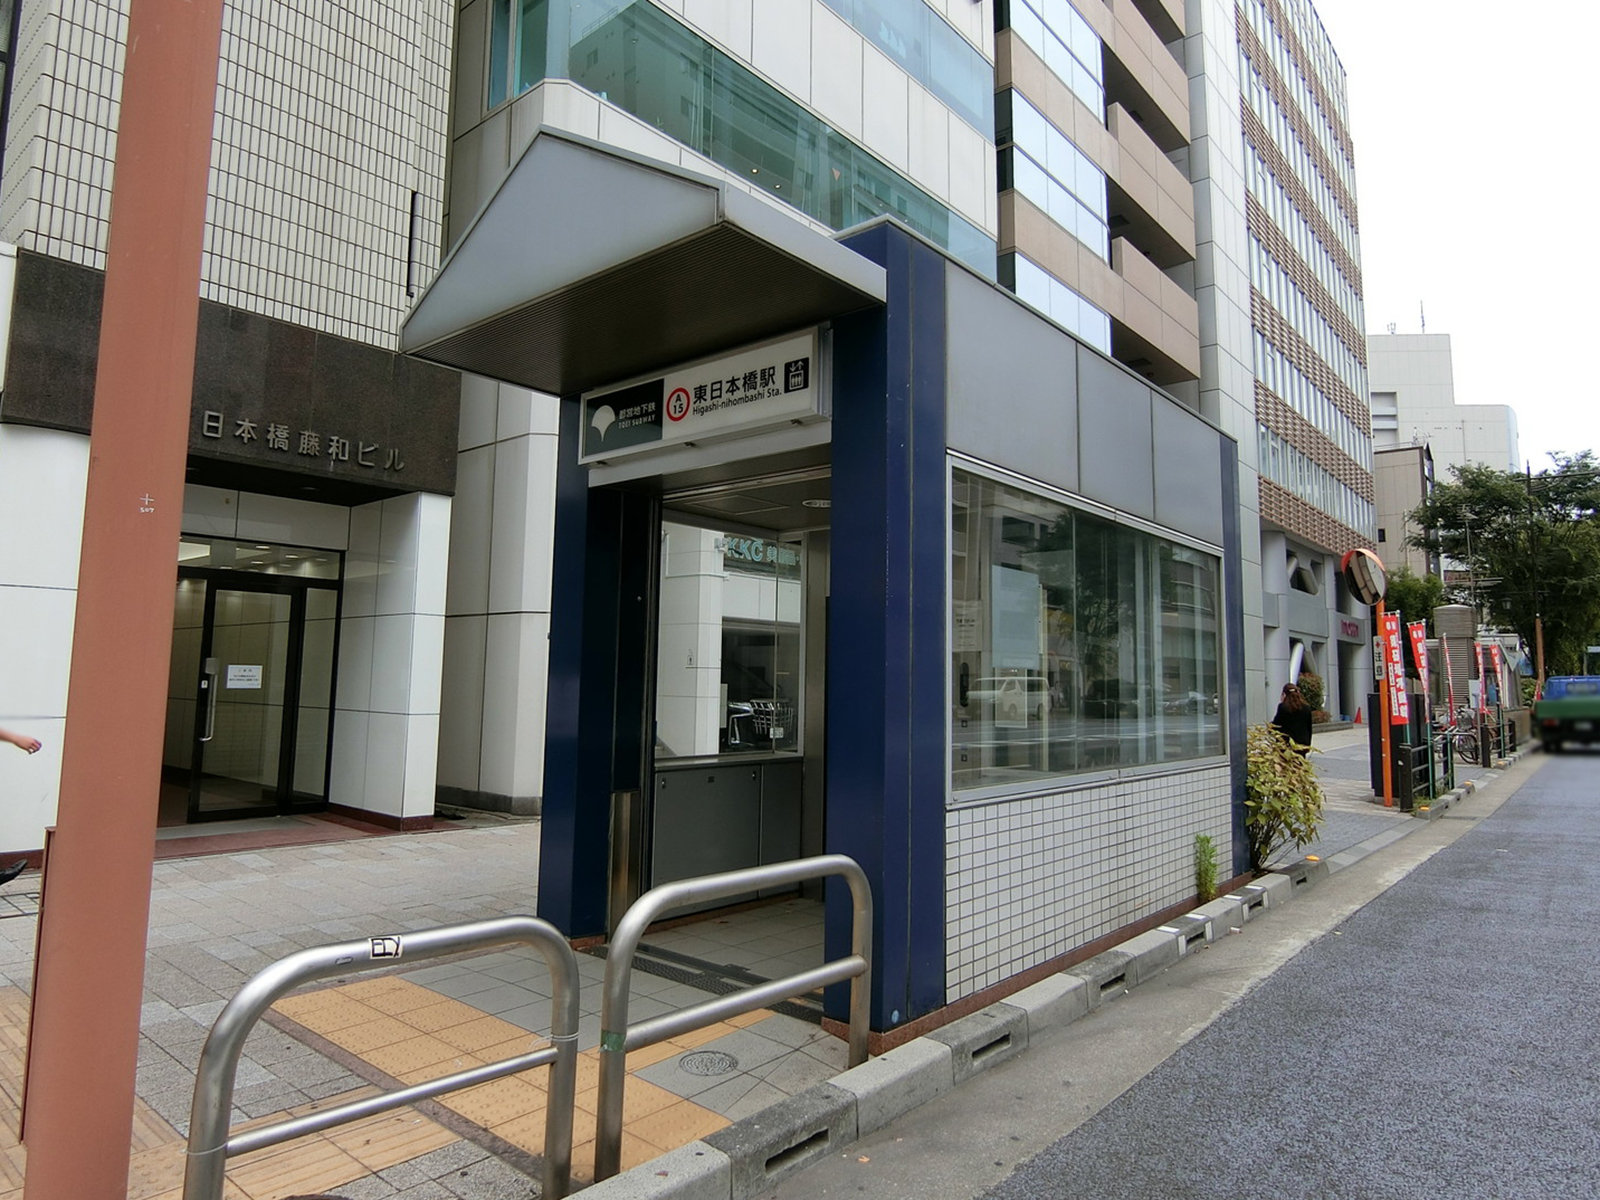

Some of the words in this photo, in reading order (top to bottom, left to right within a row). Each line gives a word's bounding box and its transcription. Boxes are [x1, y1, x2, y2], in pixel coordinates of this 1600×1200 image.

[693, 366, 776, 405] 東日本橋駅
[675, 394, 682, 403] A
[693, 390, 765, 416] Higashi-nihombashi
[767, 388, 782, 398] Sta.
[619, 401, 656, 420] 都営地下鉄
[672, 404, 684, 415] 15
[632, 414, 656, 427] SUBWAY
[202, 410, 405, 471] 日本橋藤和ビル
